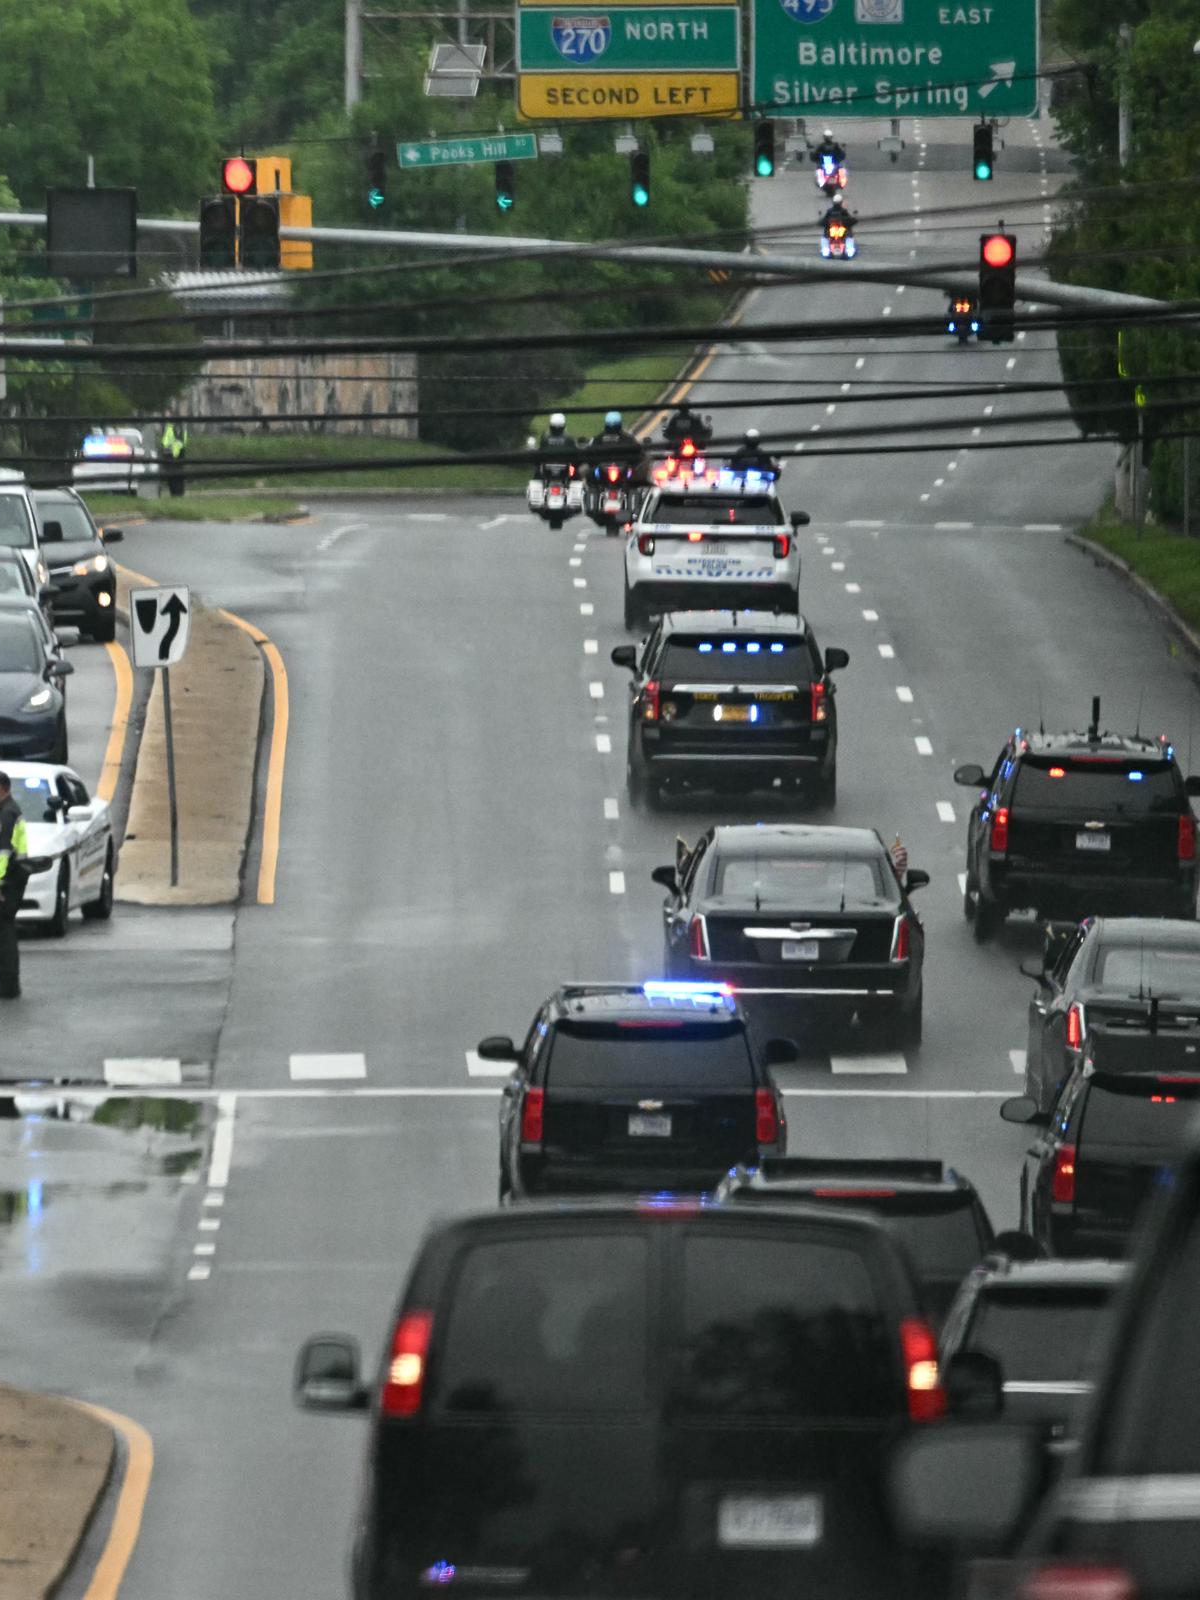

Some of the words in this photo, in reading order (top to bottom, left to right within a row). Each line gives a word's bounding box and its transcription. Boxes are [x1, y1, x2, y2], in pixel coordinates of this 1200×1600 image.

[939, 8, 994, 25] EAST
[561, 28, 606, 54] 270
[625, 21, 709, 40] NORTH
[798, 41, 943, 66] Baltimore
[546, 87, 640, 106] SECOND
[653, 86, 712, 104] LEFT
[773, 81, 858, 105] Silver
[874, 81, 969, 111] Spring
[482, 142, 507, 157] Hill
